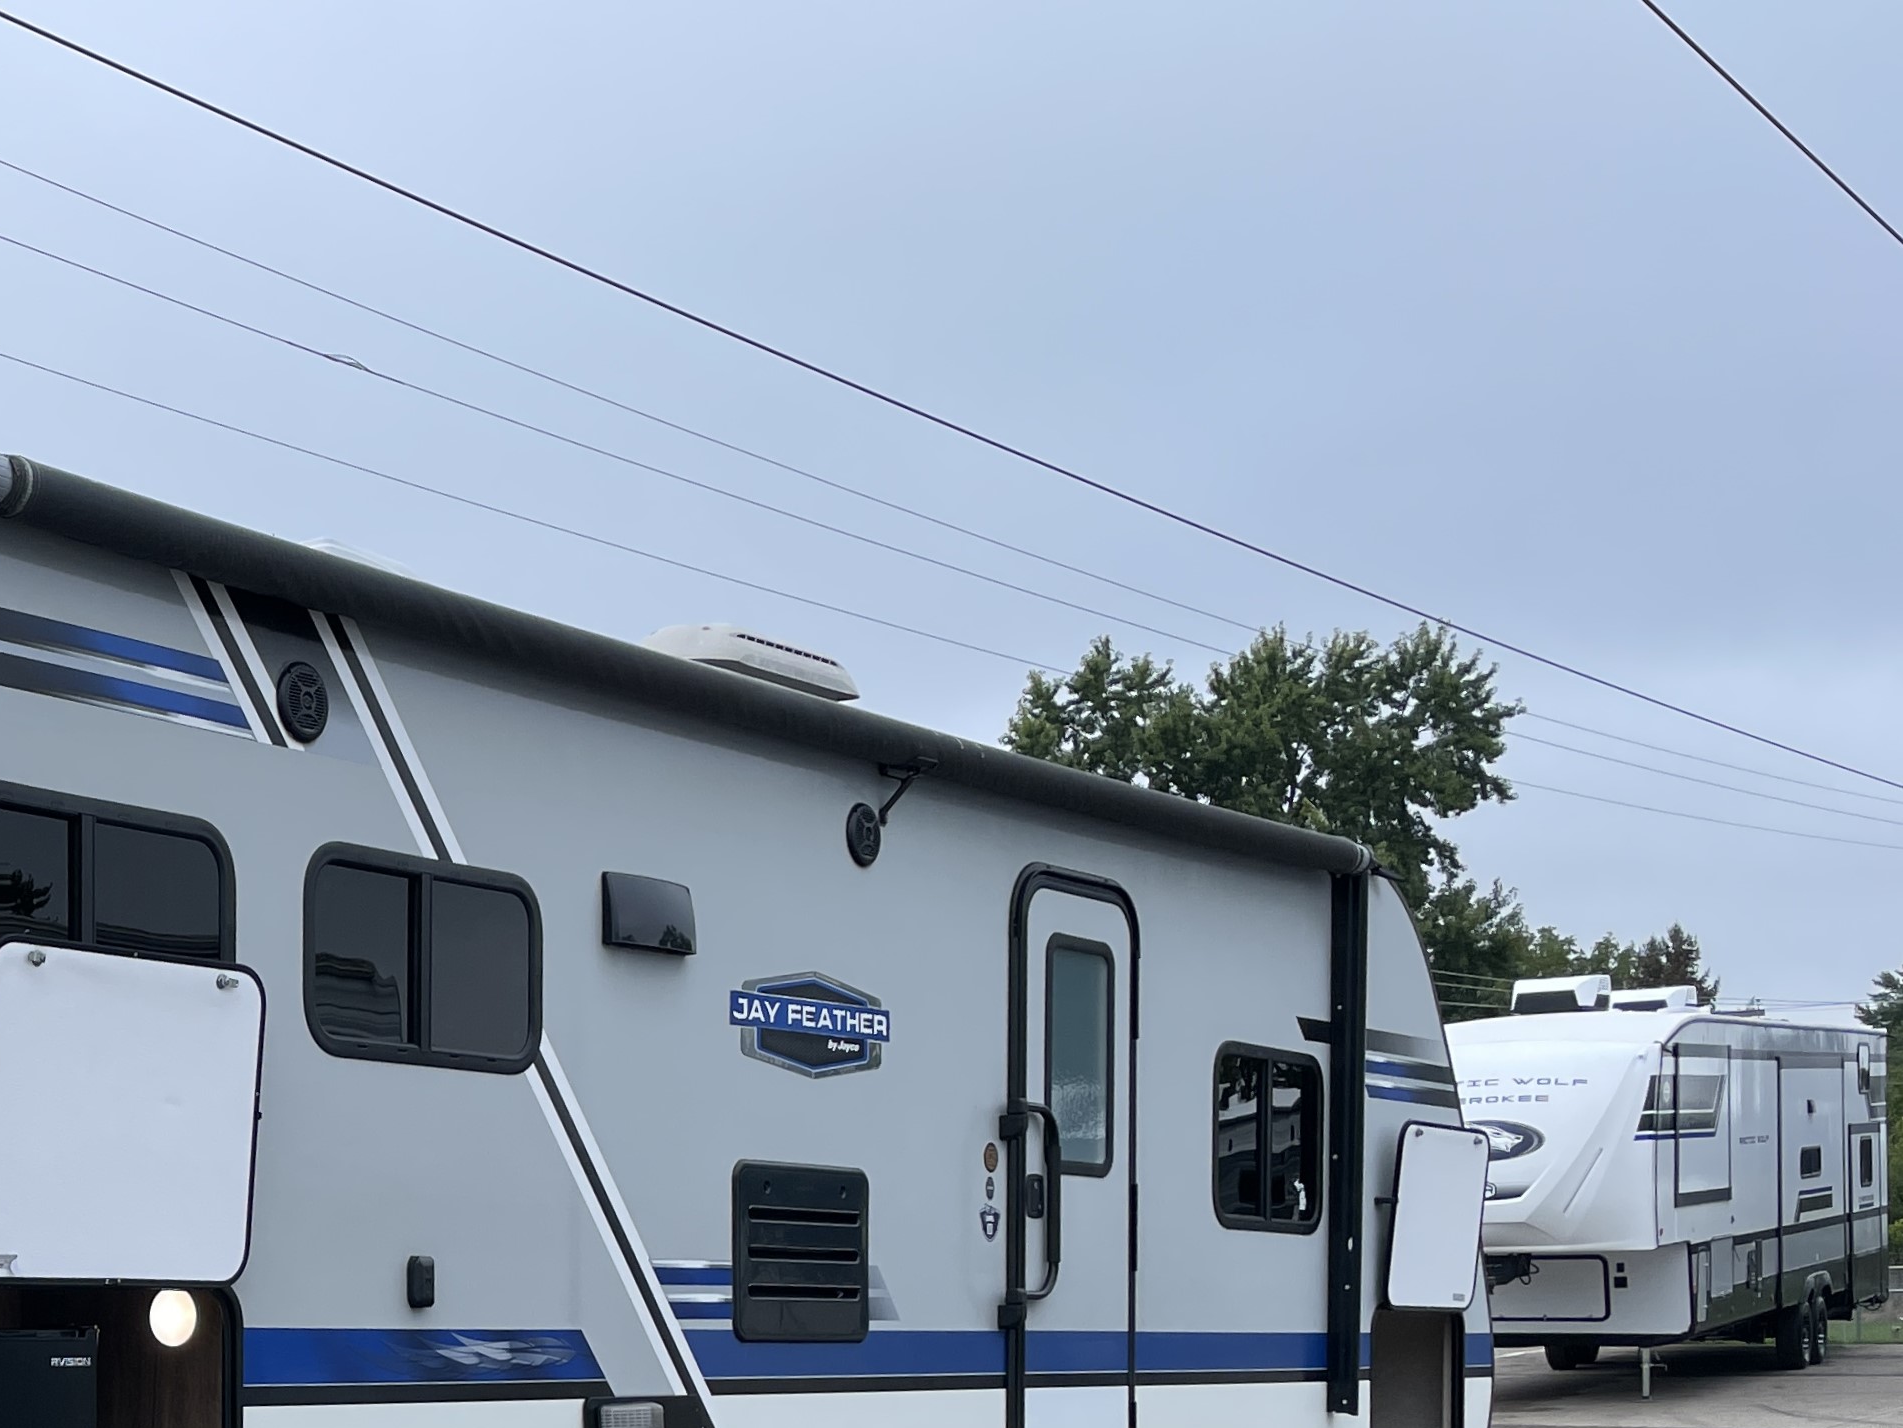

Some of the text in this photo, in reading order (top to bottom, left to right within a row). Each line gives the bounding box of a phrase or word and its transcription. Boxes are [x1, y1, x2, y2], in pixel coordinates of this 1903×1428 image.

[732, 997, 888, 1037] JAY FEATHER
[827, 1039, 860, 1053] by Jayco
[1456, 1077, 1588, 1088] TIC WOLF
